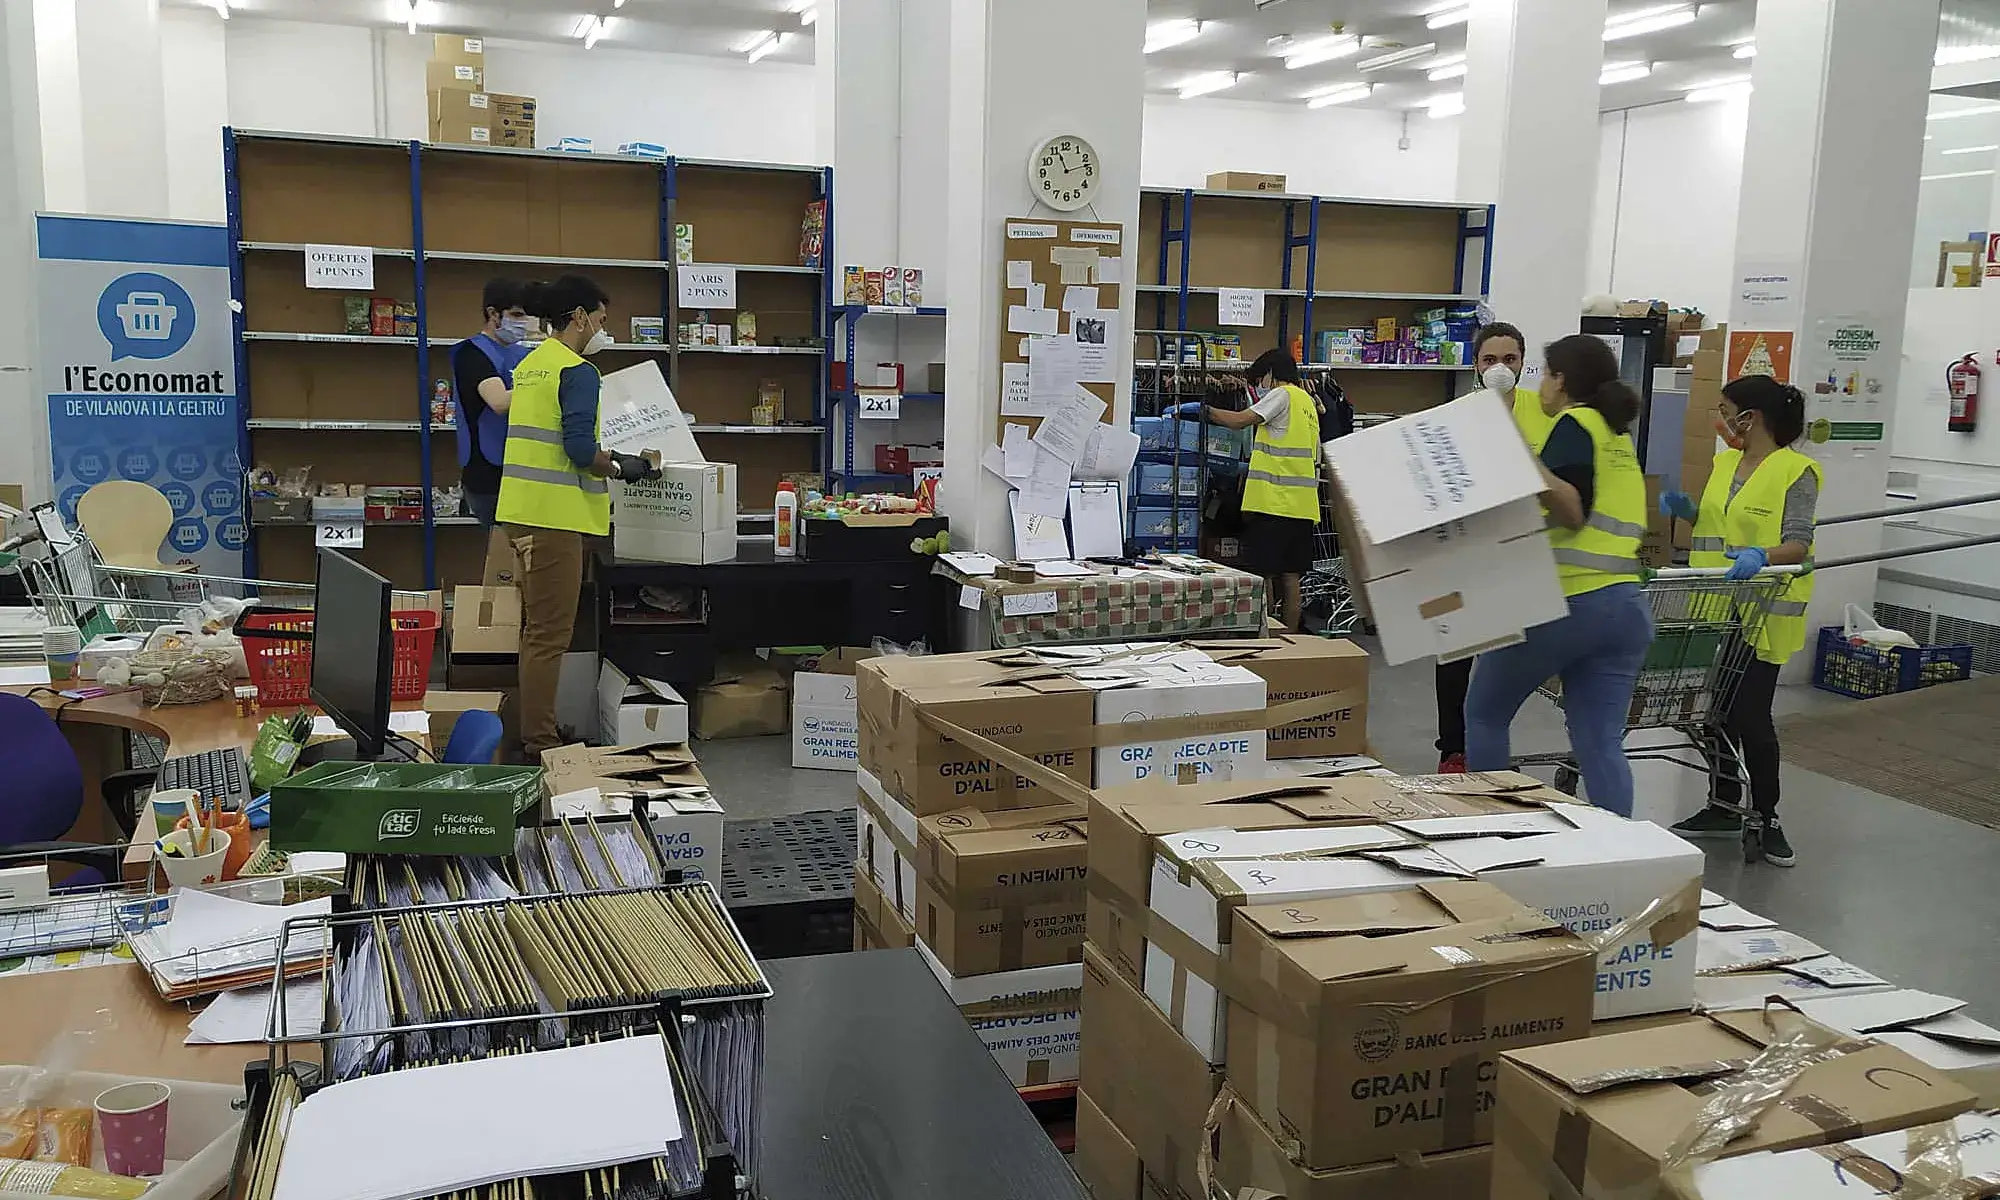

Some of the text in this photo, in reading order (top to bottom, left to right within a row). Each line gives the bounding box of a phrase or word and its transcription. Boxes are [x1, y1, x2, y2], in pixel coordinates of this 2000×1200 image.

[1050, 146, 1059, 156] 11
[1060, 141, 1071, 151] 12
[1075, 145, 1080, 154] 1
[1042, 156, 1053, 166] 10
[1082, 153, 1089, 162] 2
[1039, 168, 1047, 178] 9
[1085, 166, 1093, 176] 3
[1043, 180, 1051, 190] 8
[1081, 179, 1088, 189] 4
[1053, 189, 1060, 199] 7
[1063, 191, 1070, 202] 6
[1073, 189, 1080, 198] 5
[311, 252, 368, 263] OFERTES
[315, 267, 364, 277] 4 PUNTS
[690, 274, 724, 284] VARIS
[687, 288, 728, 297] 2 PUNTS
[1836, 329, 1875, 340] CONSUM
[1828, 340, 1880, 351] PREFERENT
[1526, 366, 1538, 374] 2x1
[64, 365, 224, 394] l'Economat
[66, 398, 225, 416] DE VILANOVA I LA GELTRÚ
[866, 398, 893, 411] 2x1
[631, 480, 683, 491] D'ALIMENT
[623, 488, 693, 502] GRAN RECAPTE
[324, 526, 355, 540] 2x1
[1267, 692, 1287, 701] ANC
[803, 737, 833, 747] GRAN
[1120, 747, 1153, 762] GRA
[940, 758, 991, 777] GRAN
[392, 812, 413, 823] tic
[442, 813, 484, 824] Enciende
[386, 821, 413, 833] tac
[433, 824, 445, 837] tu
[448, 824, 467, 835] lado
[1033, 916, 1057, 928] DELS
[1581, 918, 1611, 932] DELS
[1405, 1032, 1448, 1050] BANC
[1491, 1017, 1564, 1039] ALIMENTS
[1026, 1035, 1050, 1046] DELS
[1351, 1069, 1431, 1100] GRAN
